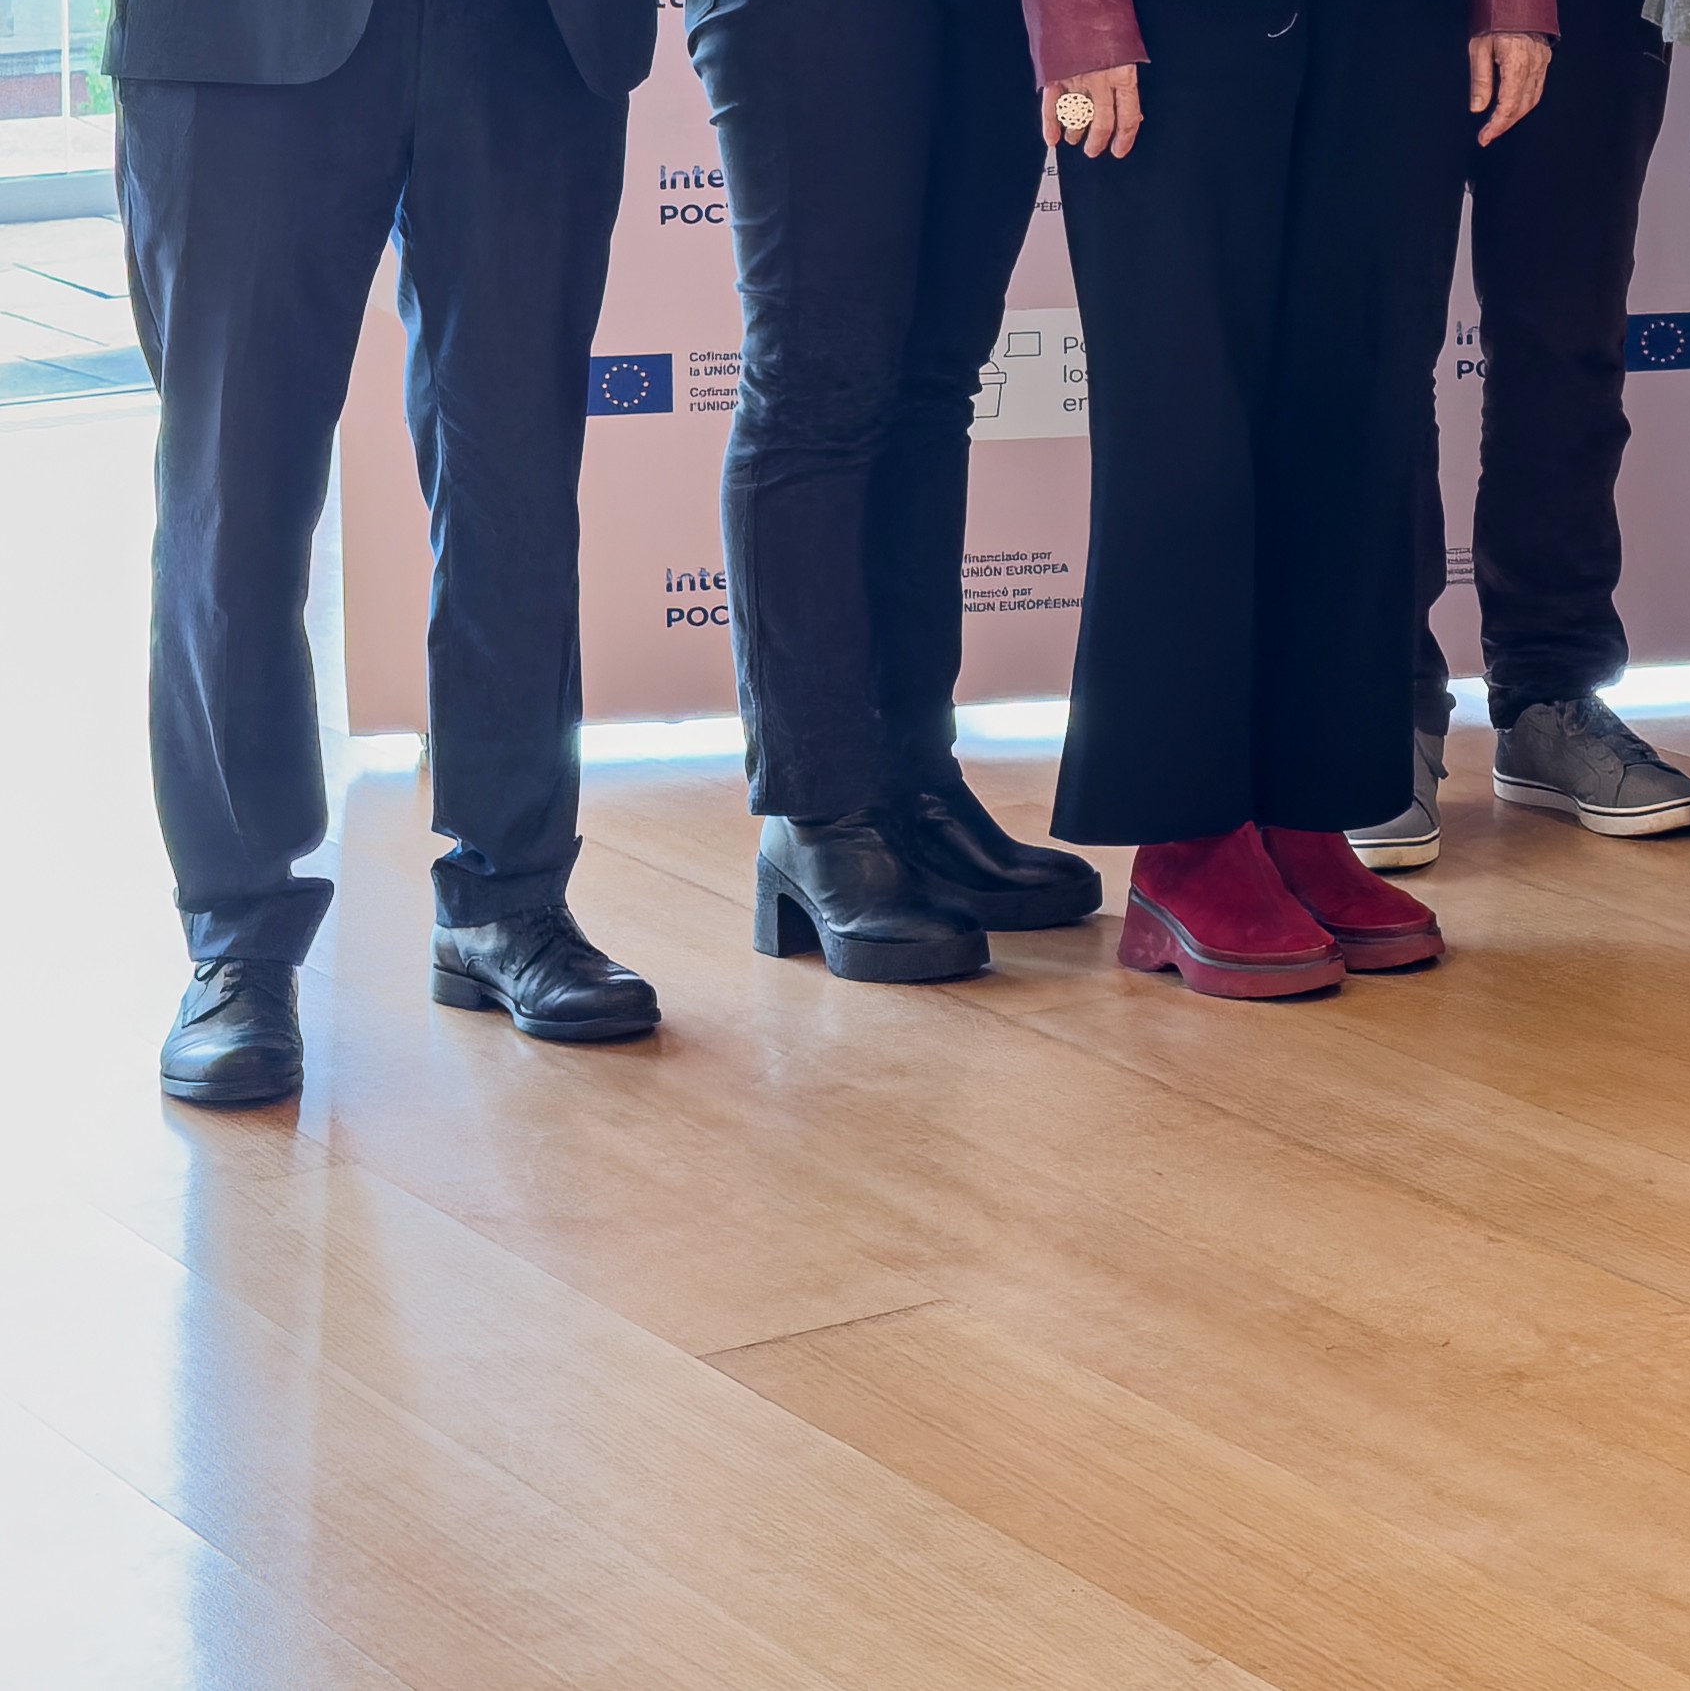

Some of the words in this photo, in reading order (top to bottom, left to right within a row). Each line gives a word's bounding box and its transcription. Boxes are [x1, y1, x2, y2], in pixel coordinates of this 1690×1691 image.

[660, 165, 725, 190] Inte
[660, 202, 728, 225] POC
[689, 352, 742, 362] Cofinan
[689, 387, 738, 397] Cofinan
[964, 551, 1027, 564] financiado
[1006, 563, 1069, 576] EUROPEA
[666, 567, 727, 592] Inte
[964, 601, 996, 613] NION
[1000, 596, 1083, 612] EUROPÉENN
[666, 605, 730, 628] POC
